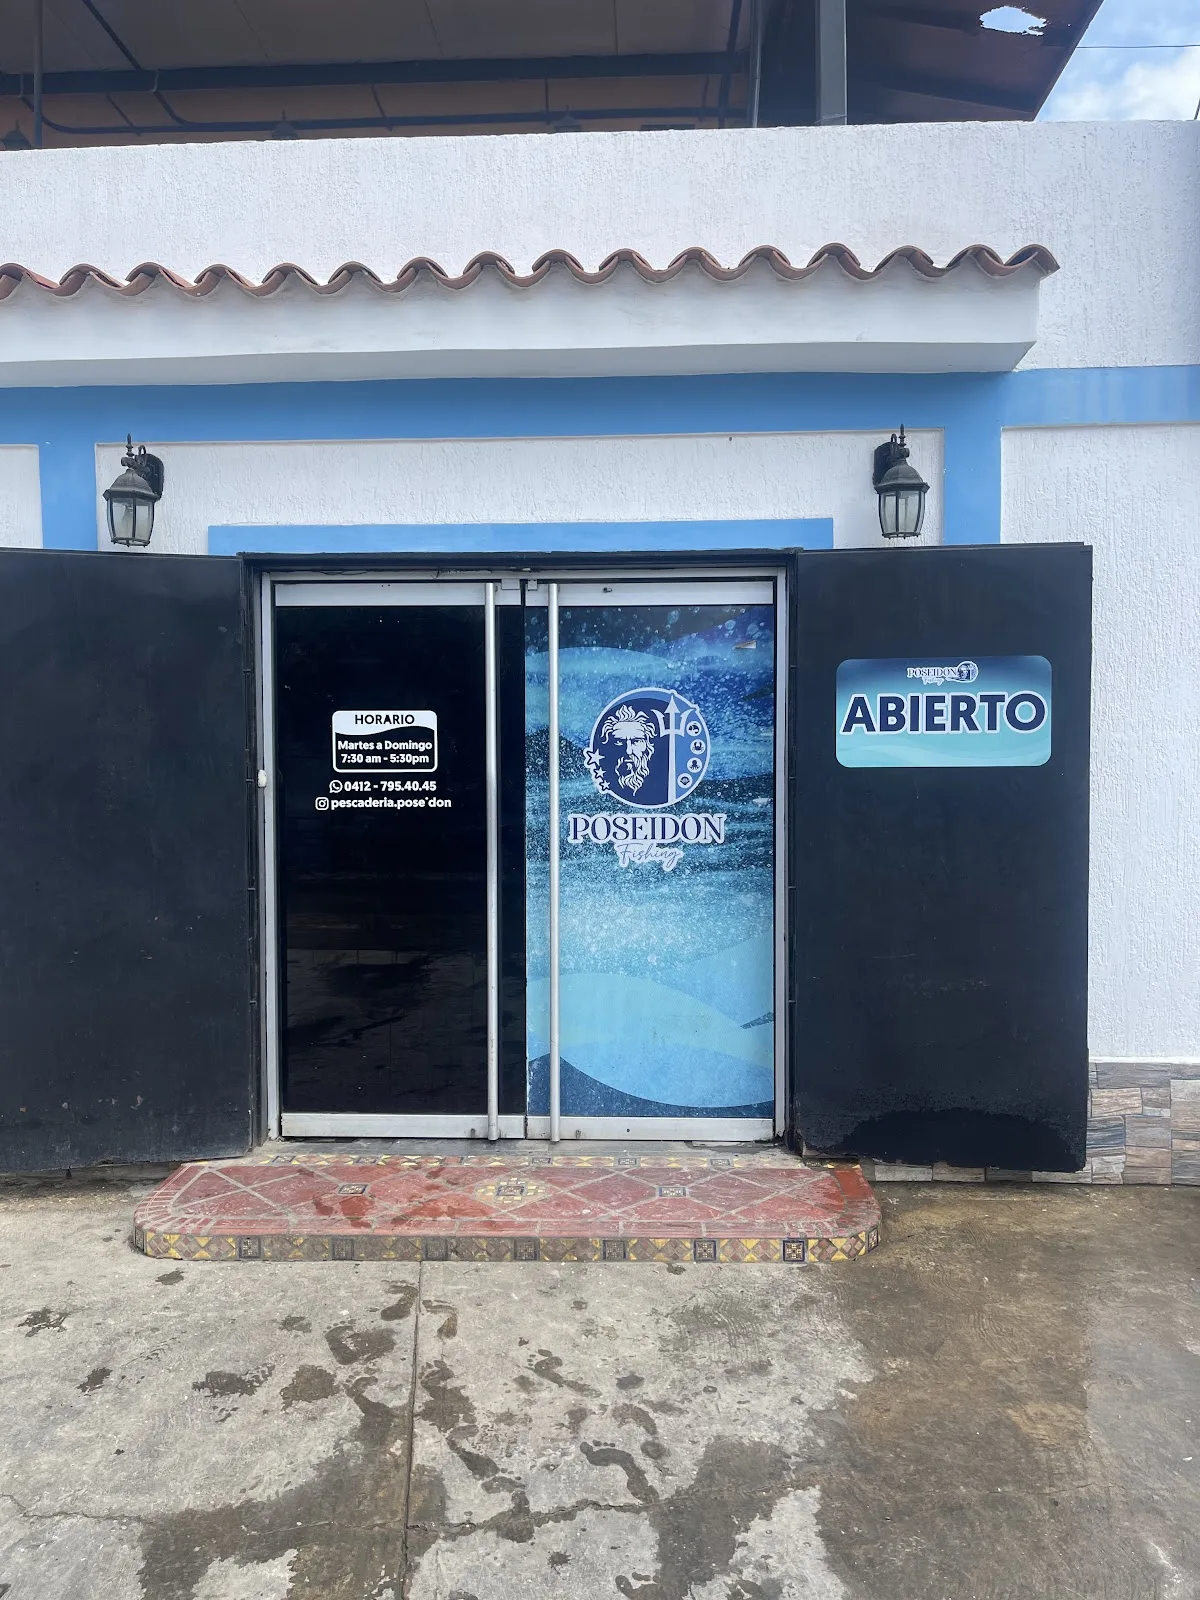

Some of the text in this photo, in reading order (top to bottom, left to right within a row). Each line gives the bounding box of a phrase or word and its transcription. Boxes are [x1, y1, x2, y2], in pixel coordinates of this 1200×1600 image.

[908, 667, 957, 678] POSEIDON
[842, 693, 1046, 732] ABIERTO
[355, 714, 415, 725] HORARIO
[337, 740, 375, 750] Martes
[384, 740, 433, 752] Domingo
[341, 754, 364, 763] 7:30
[365, 755, 382, 763] am
[389, 754, 430, 765] 5:30pm
[344, 781, 372, 791] 0412
[380, 781, 437, 791] 795.40.45
[331, 797, 452, 810] pescaderia.posedon
[571, 816, 723, 841] POSEIDON
[617, 843, 681, 869] Fishing
